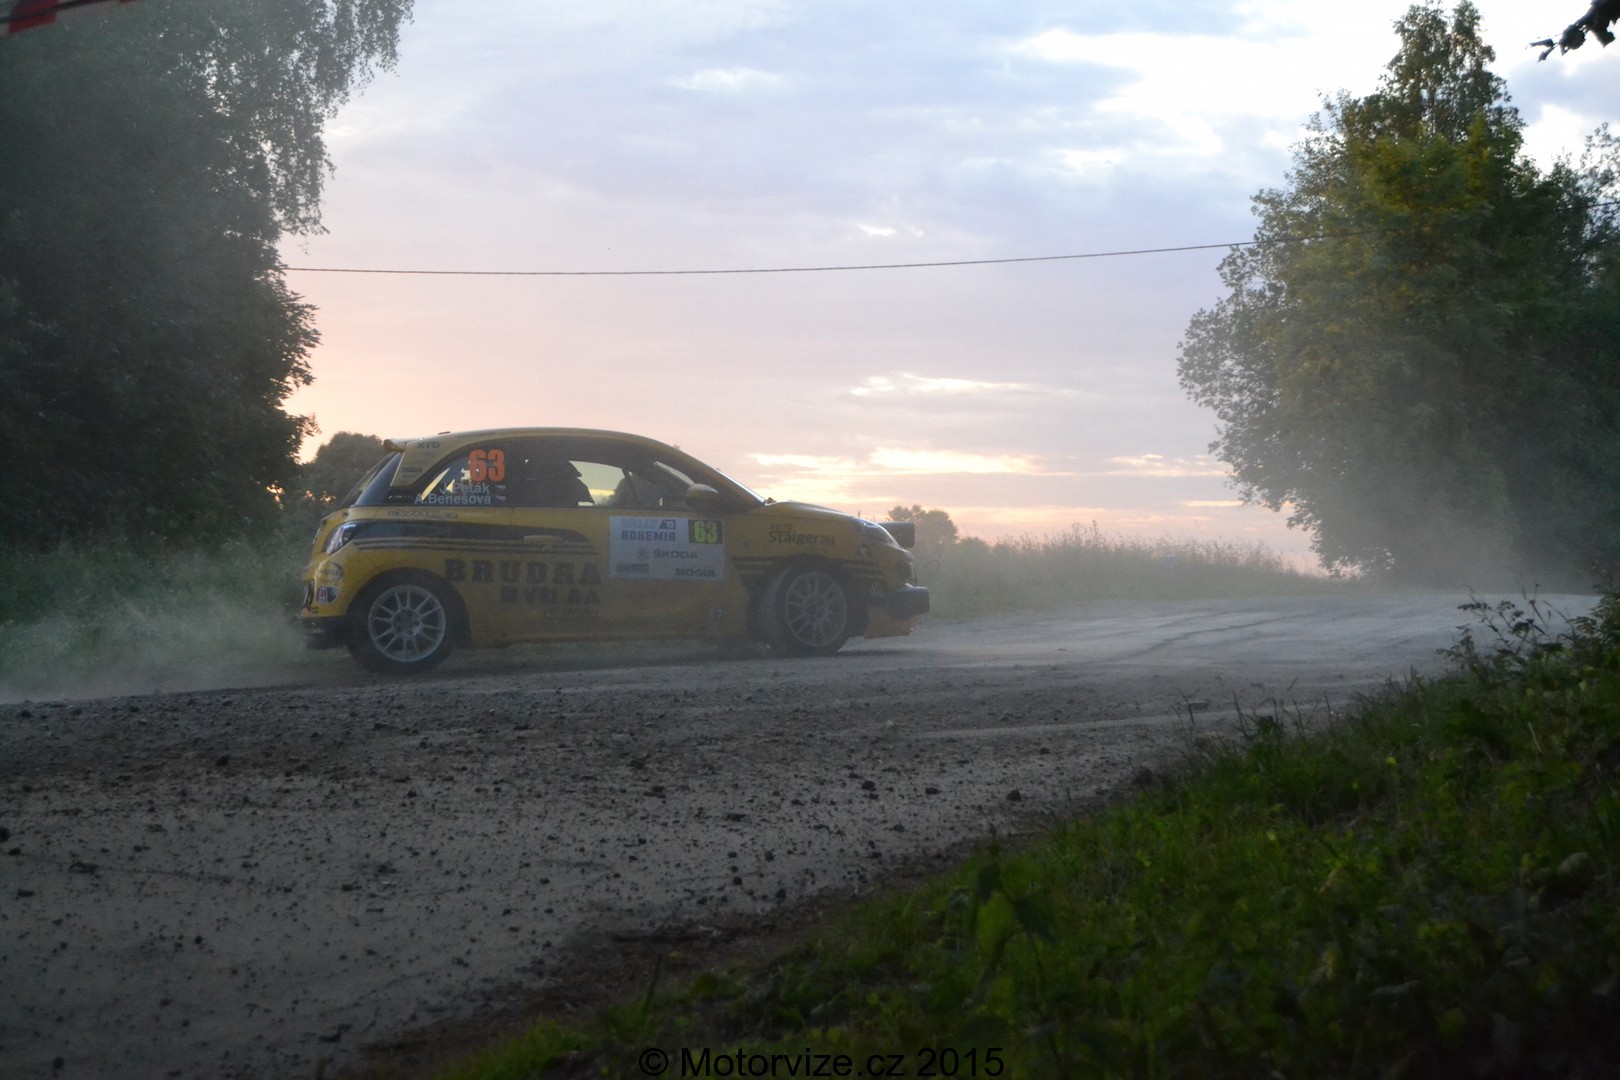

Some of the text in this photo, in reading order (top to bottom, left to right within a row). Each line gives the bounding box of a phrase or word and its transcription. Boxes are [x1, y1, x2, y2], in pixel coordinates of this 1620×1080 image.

[469, 449, 505, 482] 63
[621, 529, 676, 542] BOHEMIA
[693, 520, 719, 544] 63
[653, 548, 699, 560] ŠKODA
[675, 567, 718, 578] MOGUL
